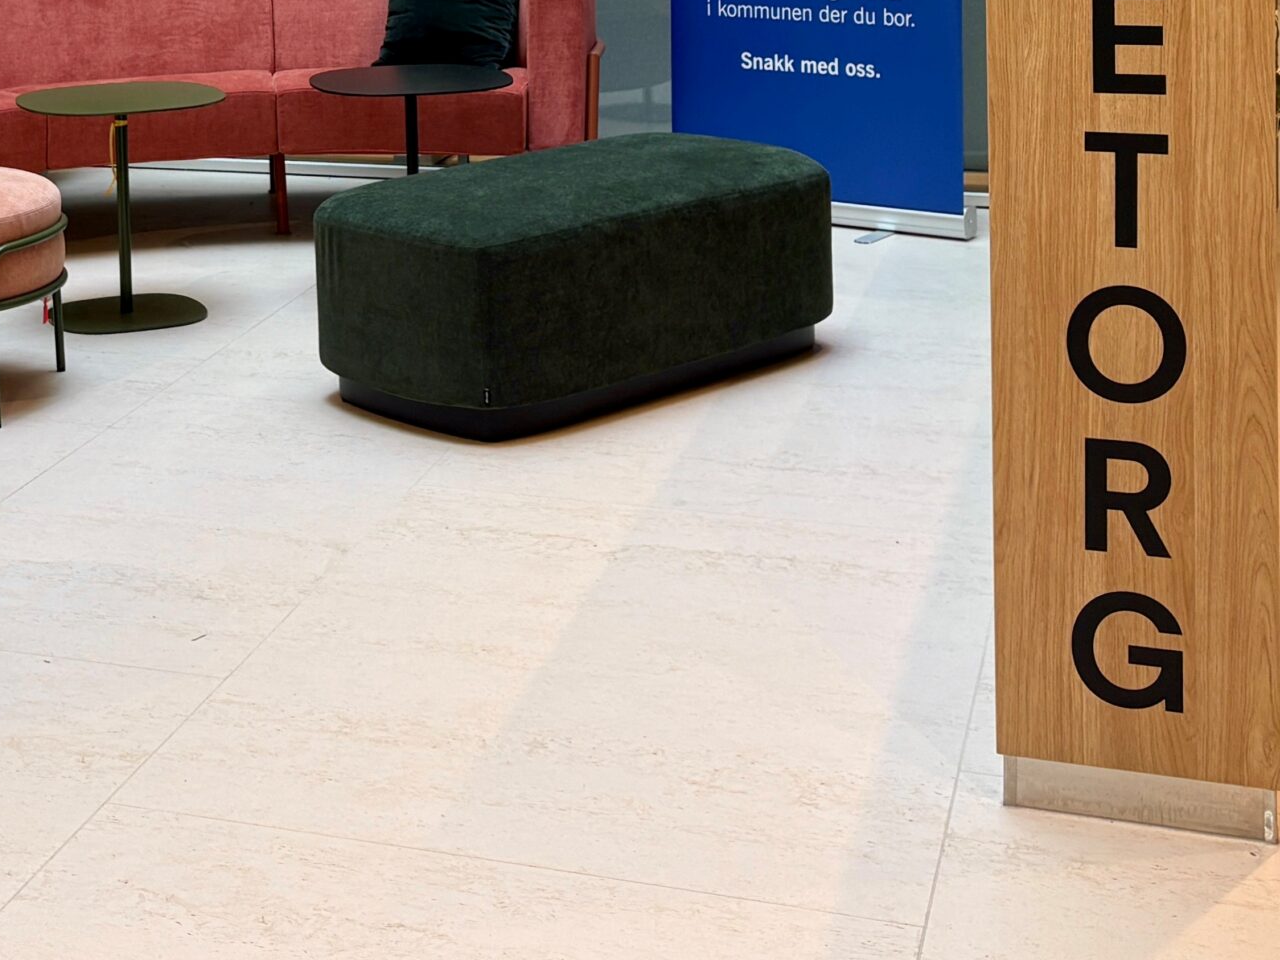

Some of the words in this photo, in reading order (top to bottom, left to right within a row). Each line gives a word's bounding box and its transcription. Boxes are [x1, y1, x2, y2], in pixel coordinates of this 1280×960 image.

[706, 0, 711, 16] i
[718, 0, 812, 22] kommunen
[819, 6, 847, 24] der
[853, 6, 876, 25] du
[883, 8, 915, 27] bor.
[741, 52, 795, 73] Snakk
[801, 57, 839, 76] med
[845, 63, 880, 78] oss.
